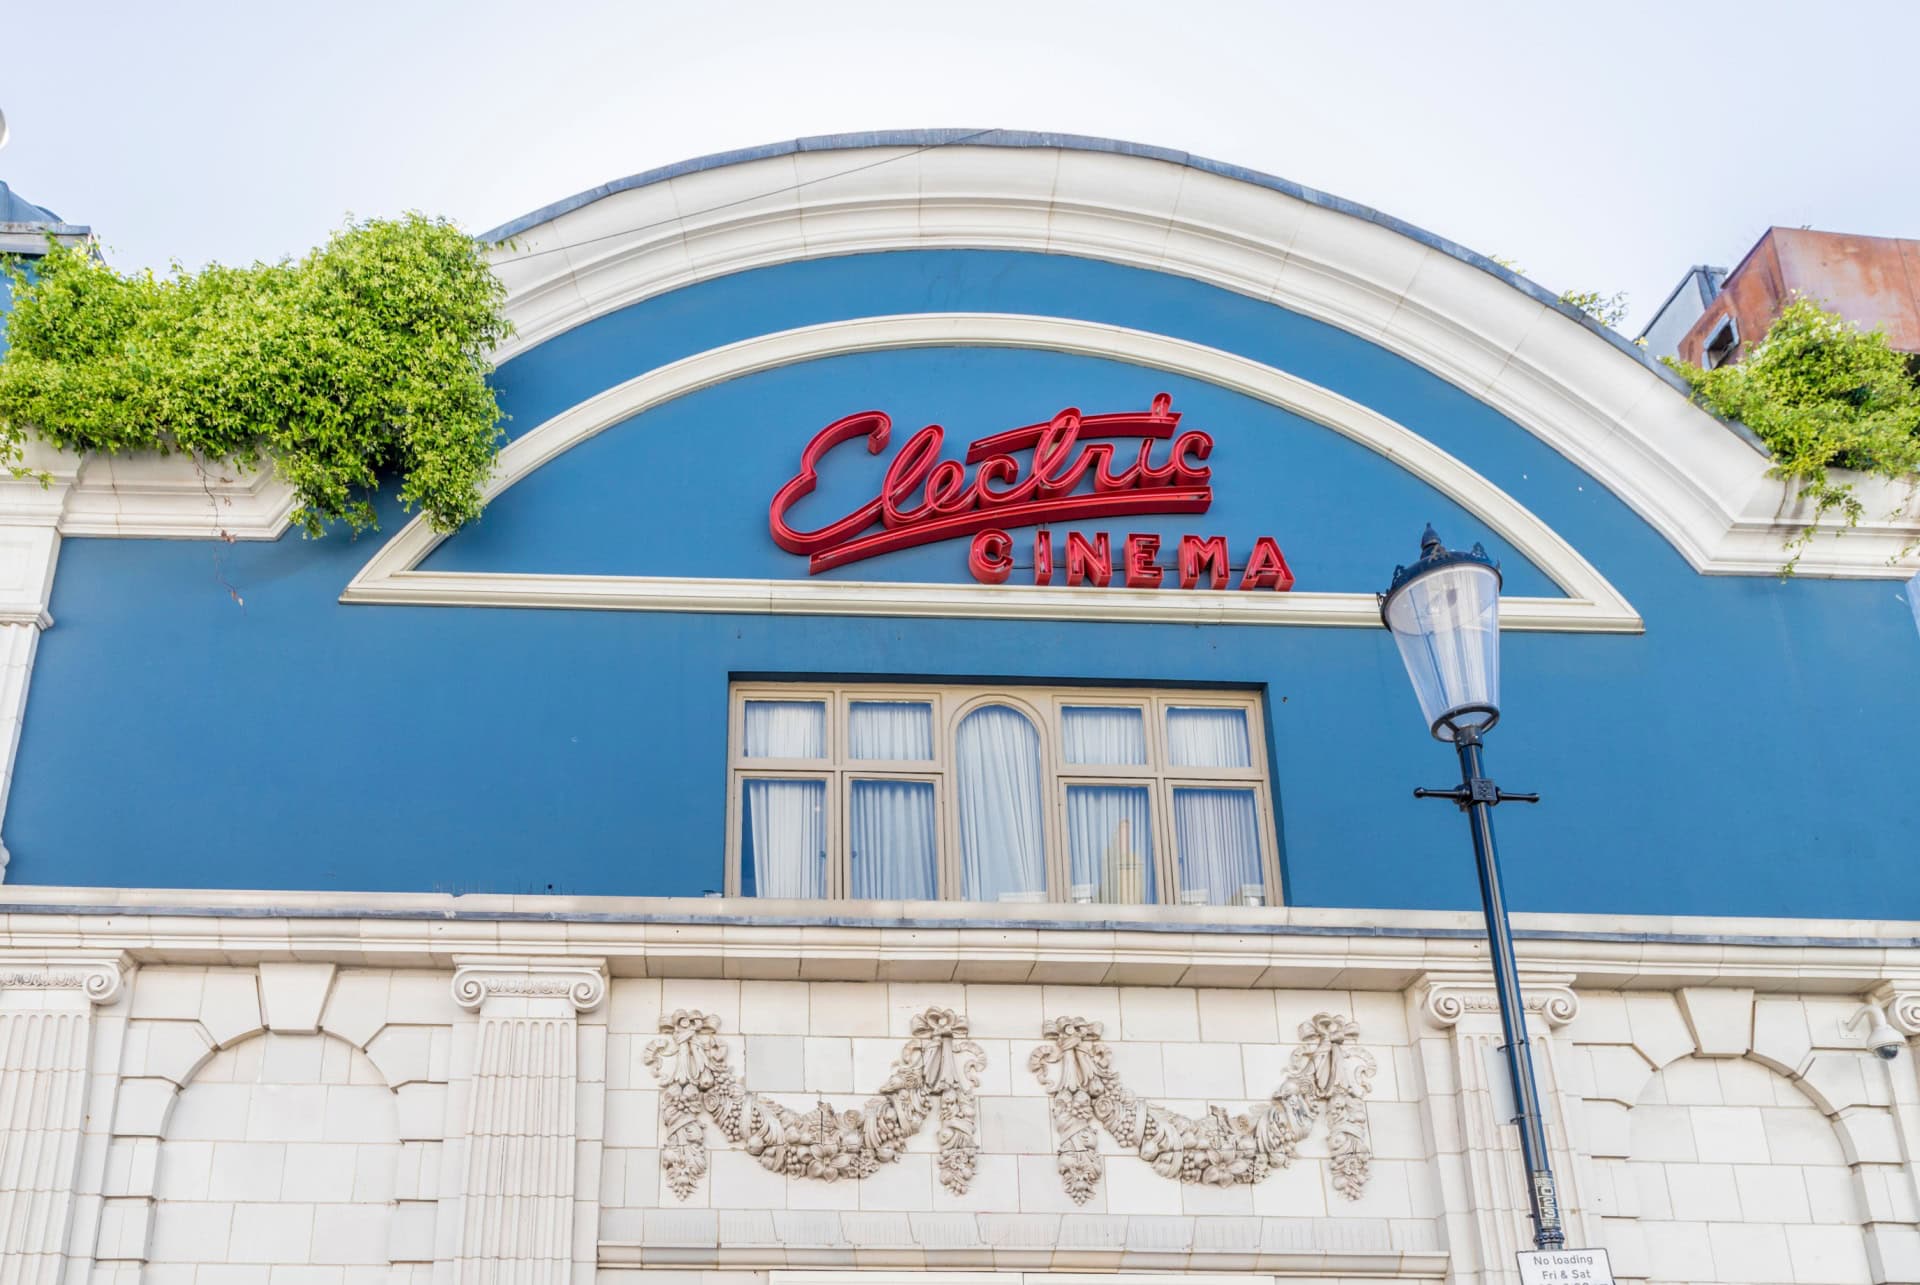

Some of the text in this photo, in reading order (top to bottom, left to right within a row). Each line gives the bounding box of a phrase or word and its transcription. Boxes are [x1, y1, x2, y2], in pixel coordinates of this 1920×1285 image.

[769, 392, 1214, 556] Electric
[968, 528, 1295, 592] CINEMA
[1533, 1255, 1593, 1265] No loading
[1542, 1269, 1592, 1280] Fri & Sat
